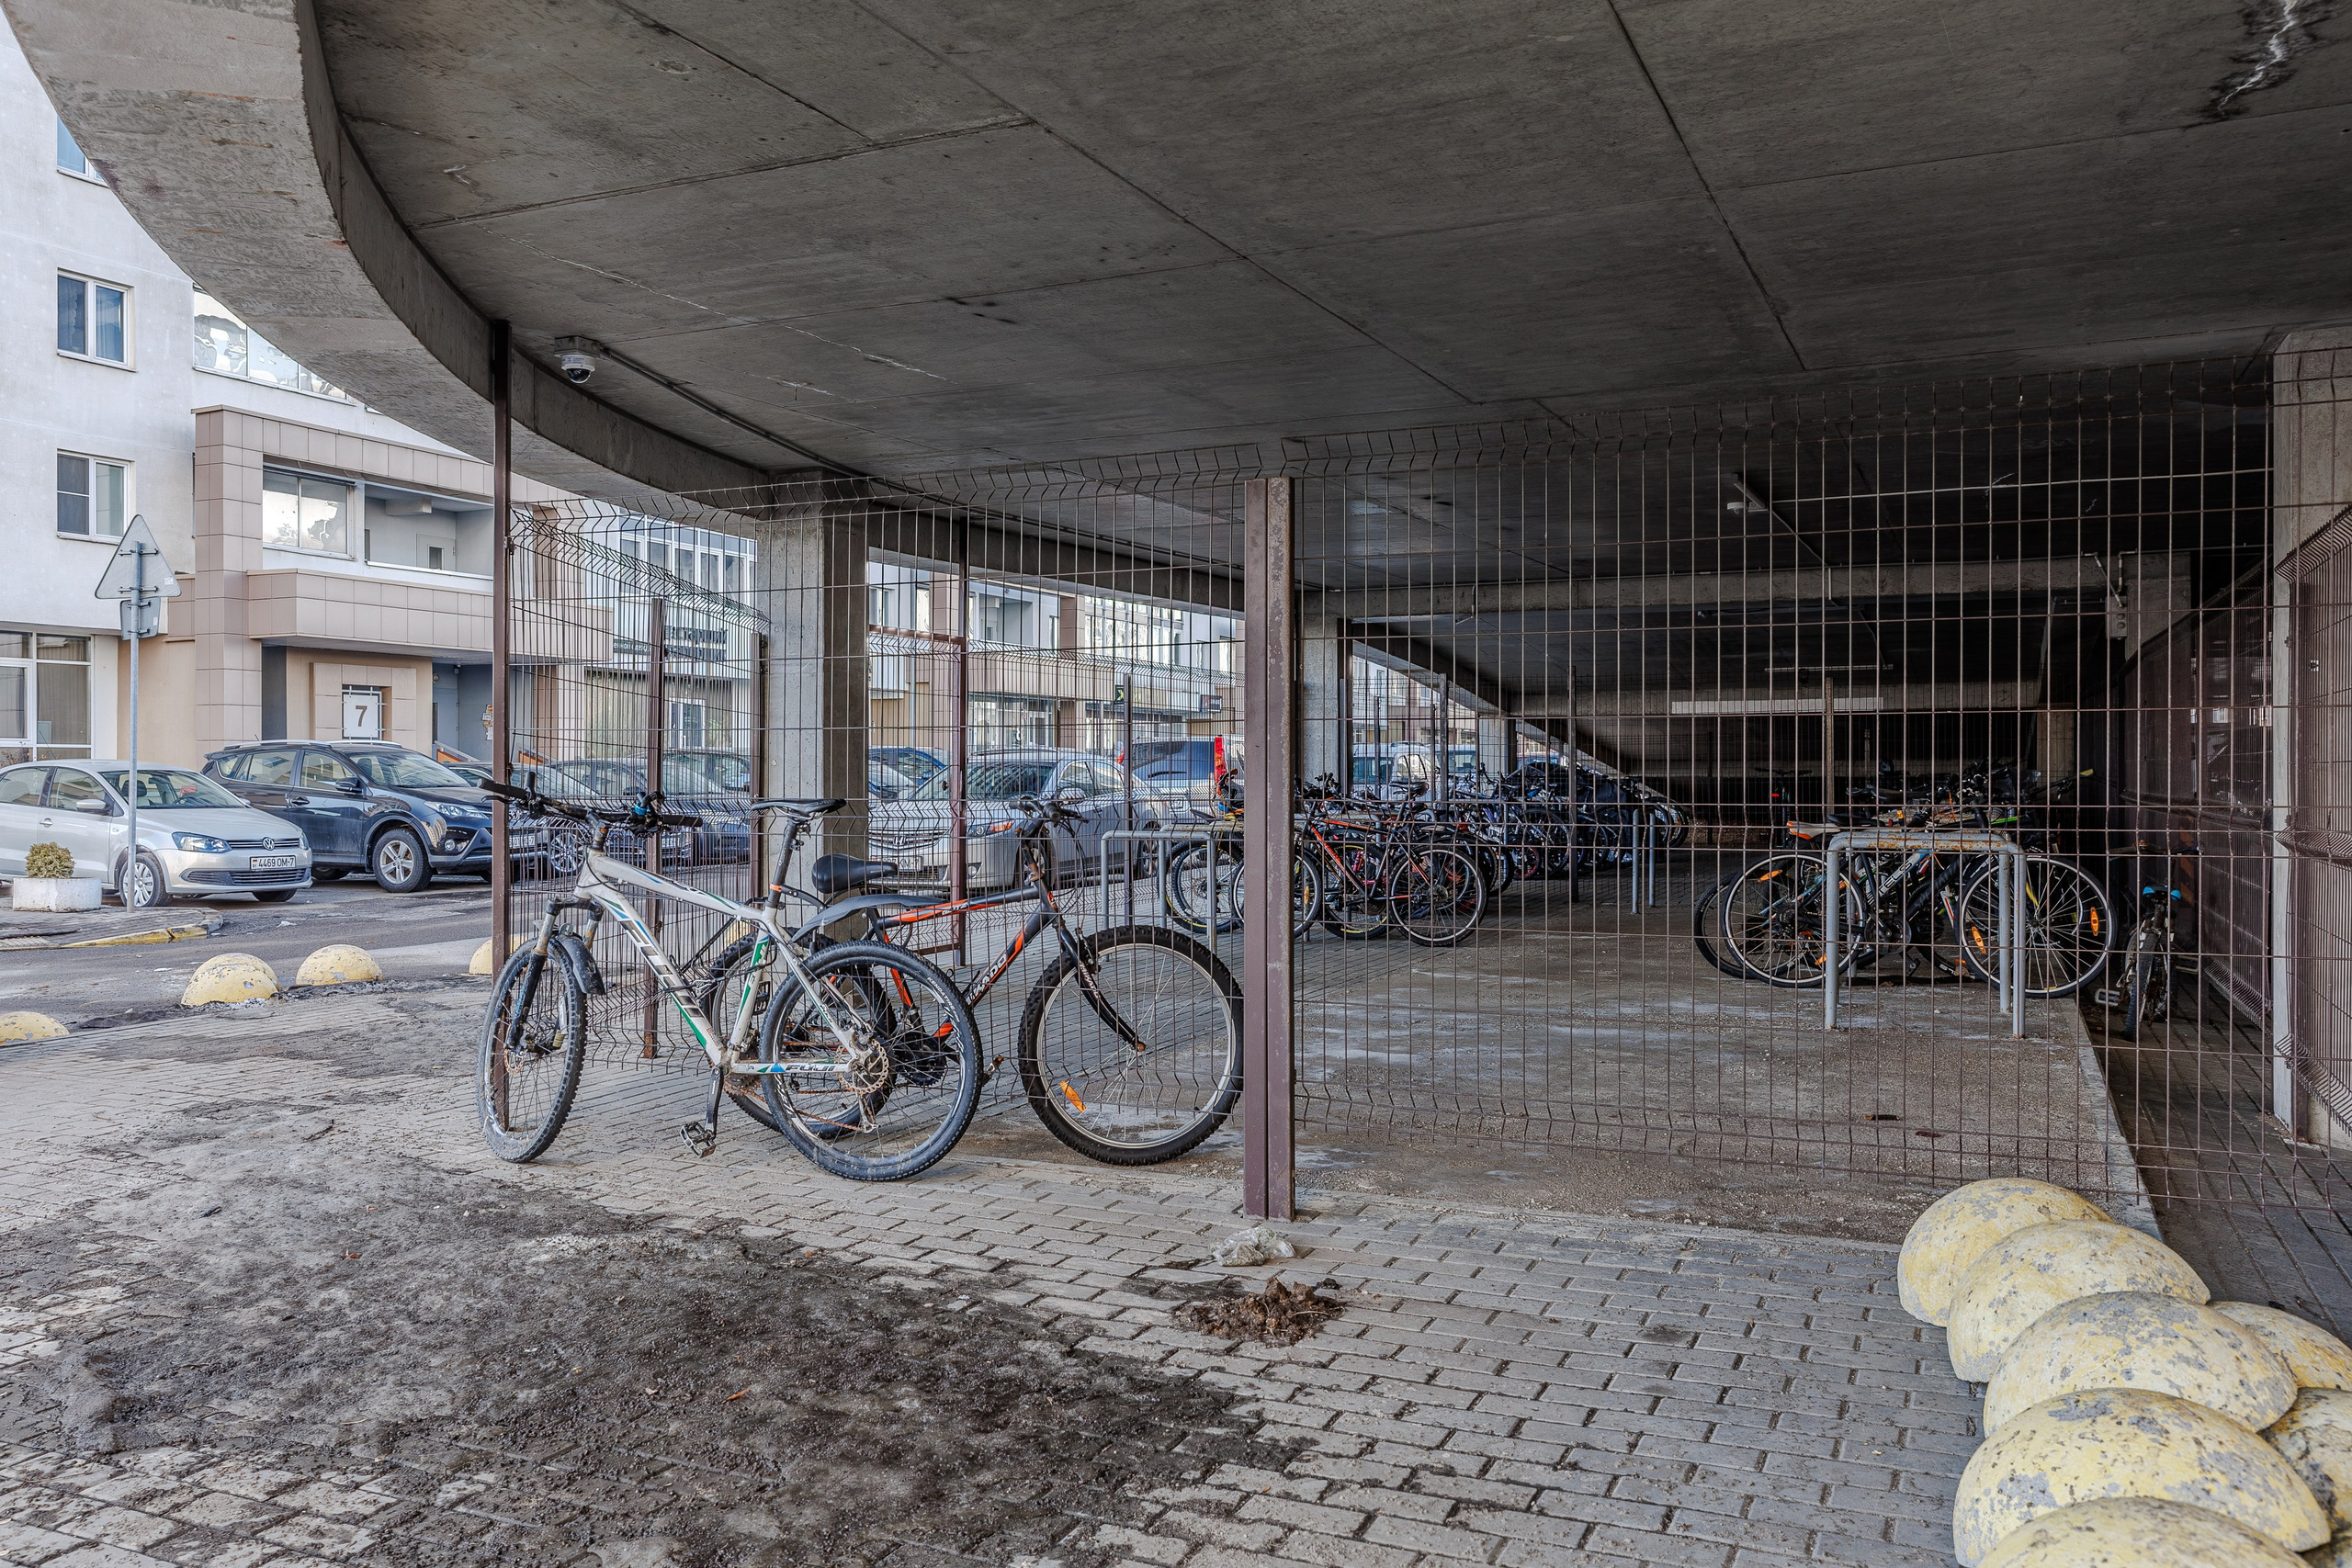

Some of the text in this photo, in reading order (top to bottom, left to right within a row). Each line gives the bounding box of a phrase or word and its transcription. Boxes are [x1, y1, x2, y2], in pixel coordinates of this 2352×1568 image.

[356, 705, 368, 727] 7
[258, 858, 294, 868] 4469 OM-7
[1878, 860, 1912, 894] TELS
[618, 920, 704, 1018] FUJI
